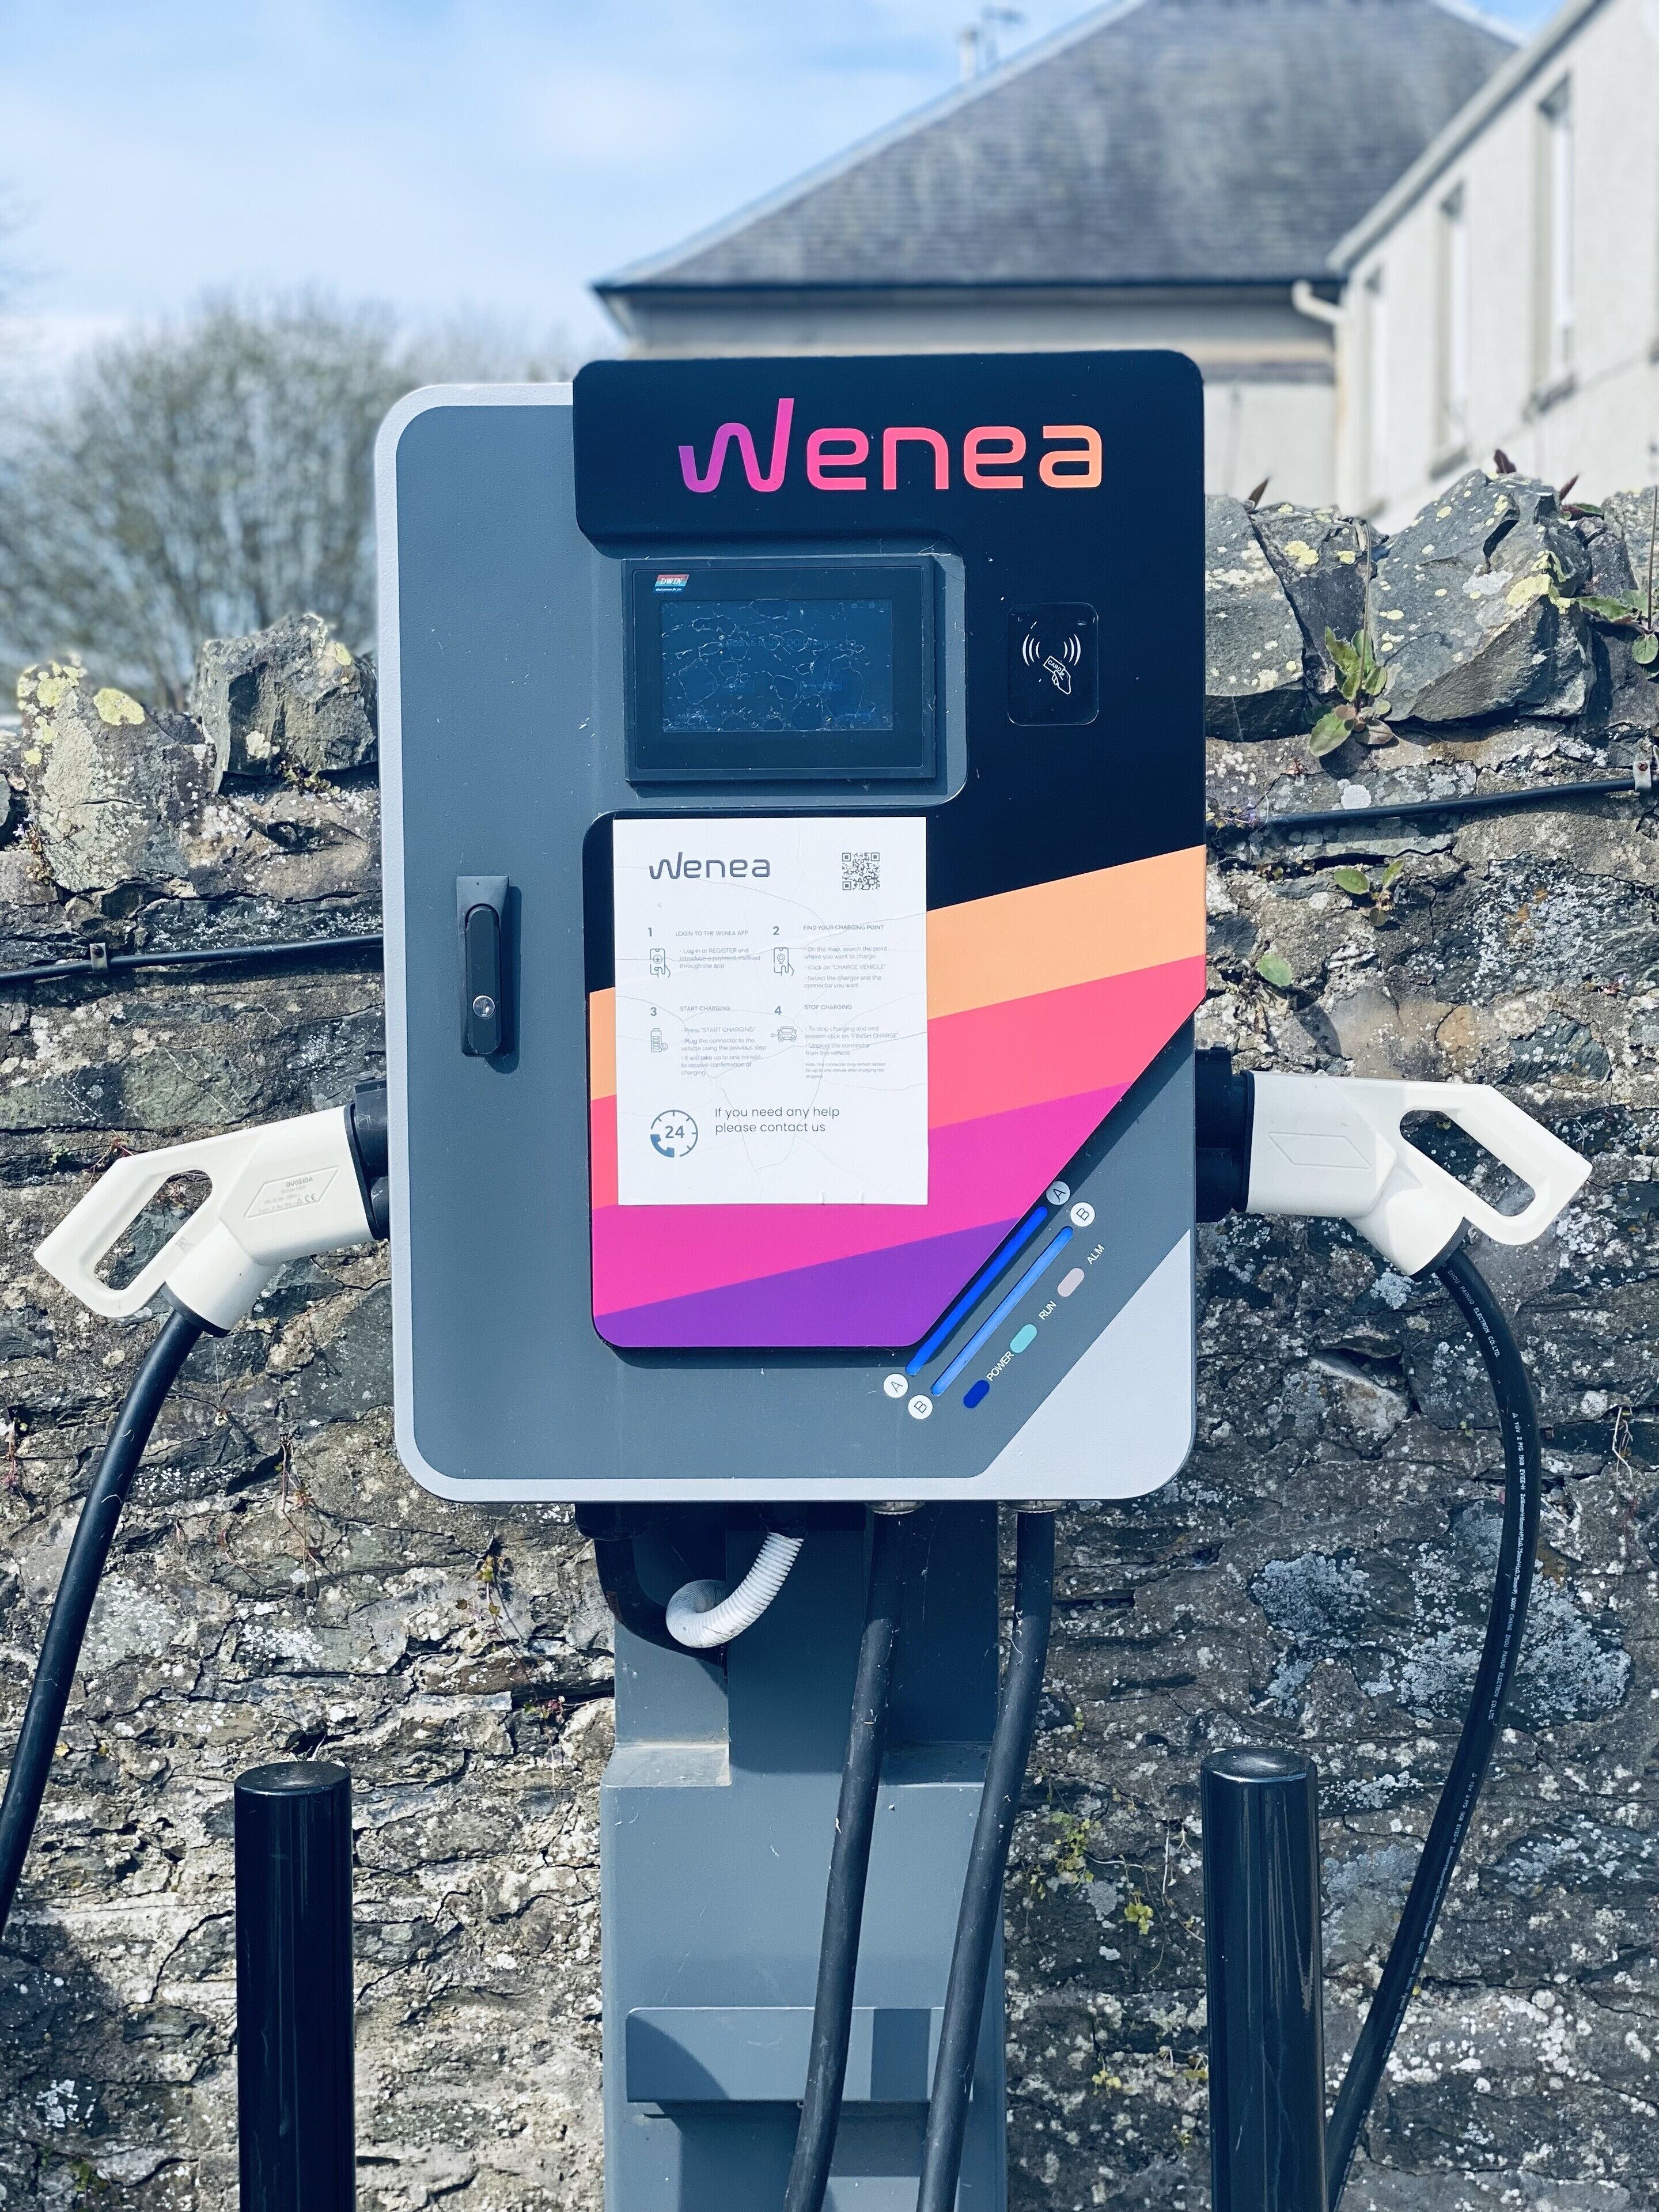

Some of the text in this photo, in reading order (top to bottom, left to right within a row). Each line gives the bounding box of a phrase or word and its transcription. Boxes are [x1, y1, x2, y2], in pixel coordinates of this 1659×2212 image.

[679, 398, 1101, 493] Wenea
[1048, 660, 1062, 672] CARD
[649, 851, 771, 879] Wenea
[648, 927, 652, 937] 1
[773, 926, 779, 935] 2
[650, 1007, 657, 1016] 3
[774, 1006, 782, 1014] 4
[715, 1107, 839, 1120] If you need any help
[665, 1126, 685, 1138] 24
[715, 1123, 825, 1135] please contact us
[286, 1177, 313, 1187] DUOSIDA
[1052, 1188, 1066, 1202] A
[1077, 1208, 1089, 1221] B
[1086, 1244, 1105, 1265] ALM
[1447, 1269, 1461, 1284] ZHOU
[1460, 1286, 1475, 1305] PAINUO
[1474, 1307, 1490, 1334] ELECTRON
[1038, 1300, 1057, 1321] RUN
[986, 1351, 1014, 1382] POWER
[891, 1380, 903, 1393] A
[914, 1400, 927, 1414] B
[1494, 1672, 1503, 1698] ELECTRON
